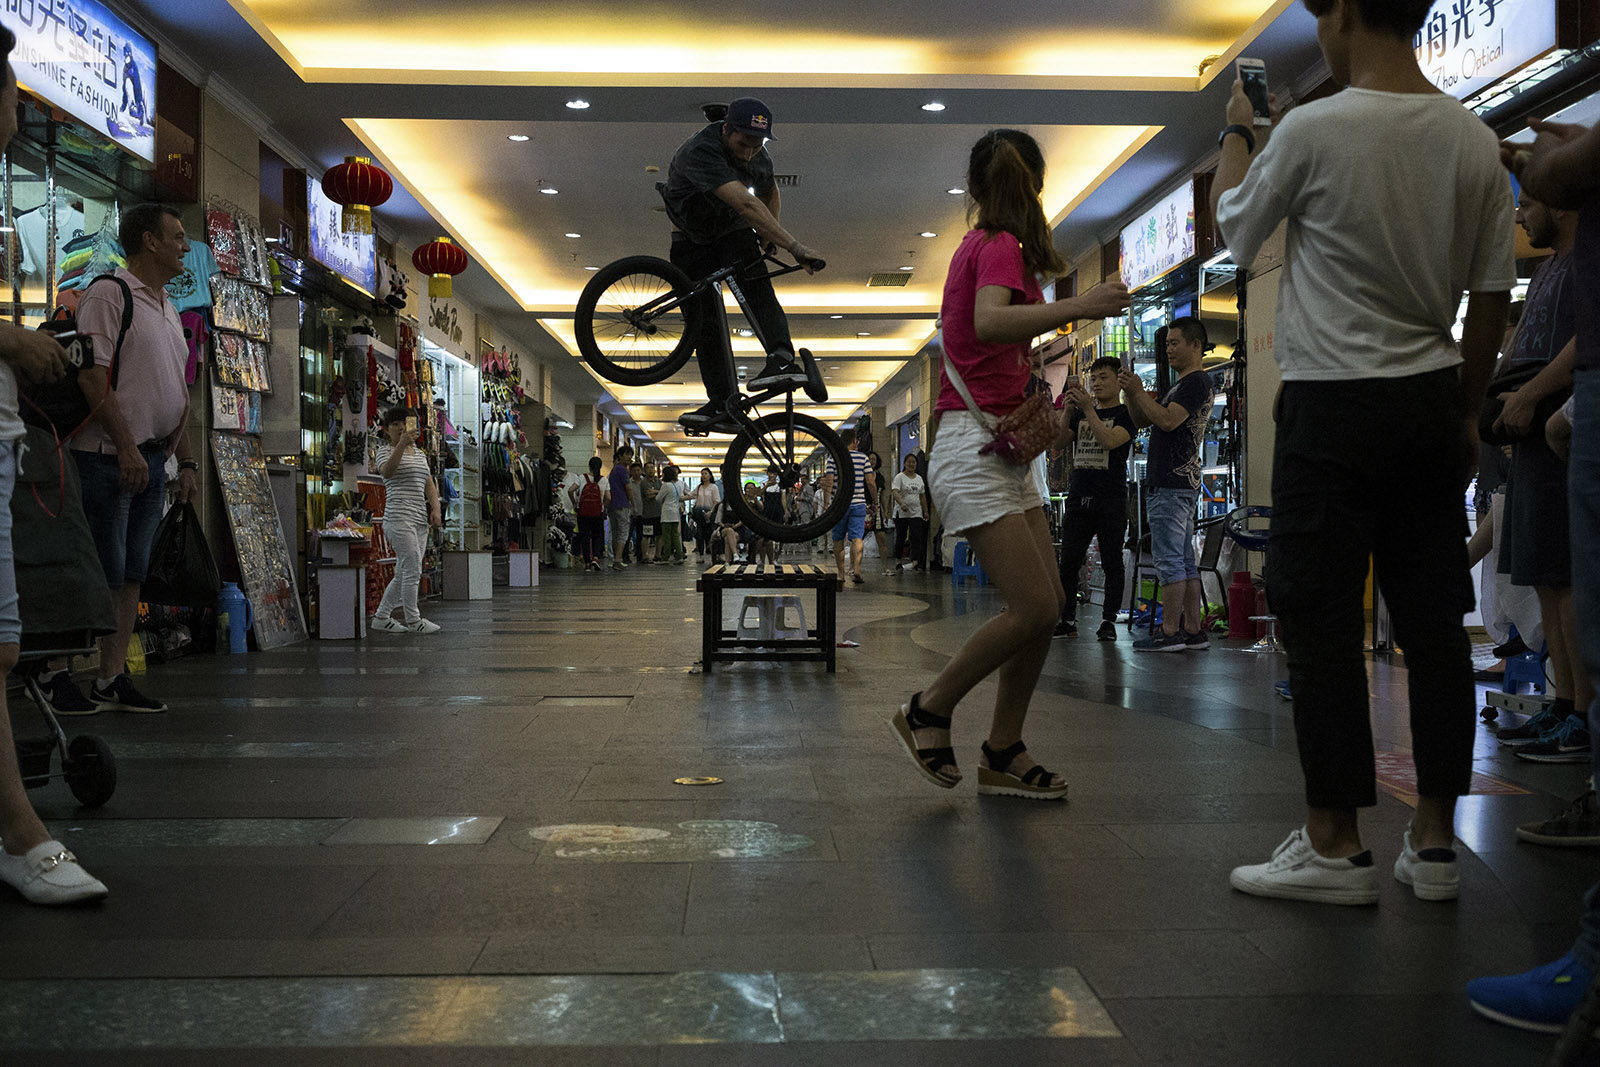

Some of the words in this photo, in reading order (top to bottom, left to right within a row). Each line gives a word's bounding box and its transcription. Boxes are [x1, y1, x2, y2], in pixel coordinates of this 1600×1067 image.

[1461, 28, 1504, 80] Optical
[70, 75, 119, 121] FASHION
[726, 275, 746, 304] FIEND
